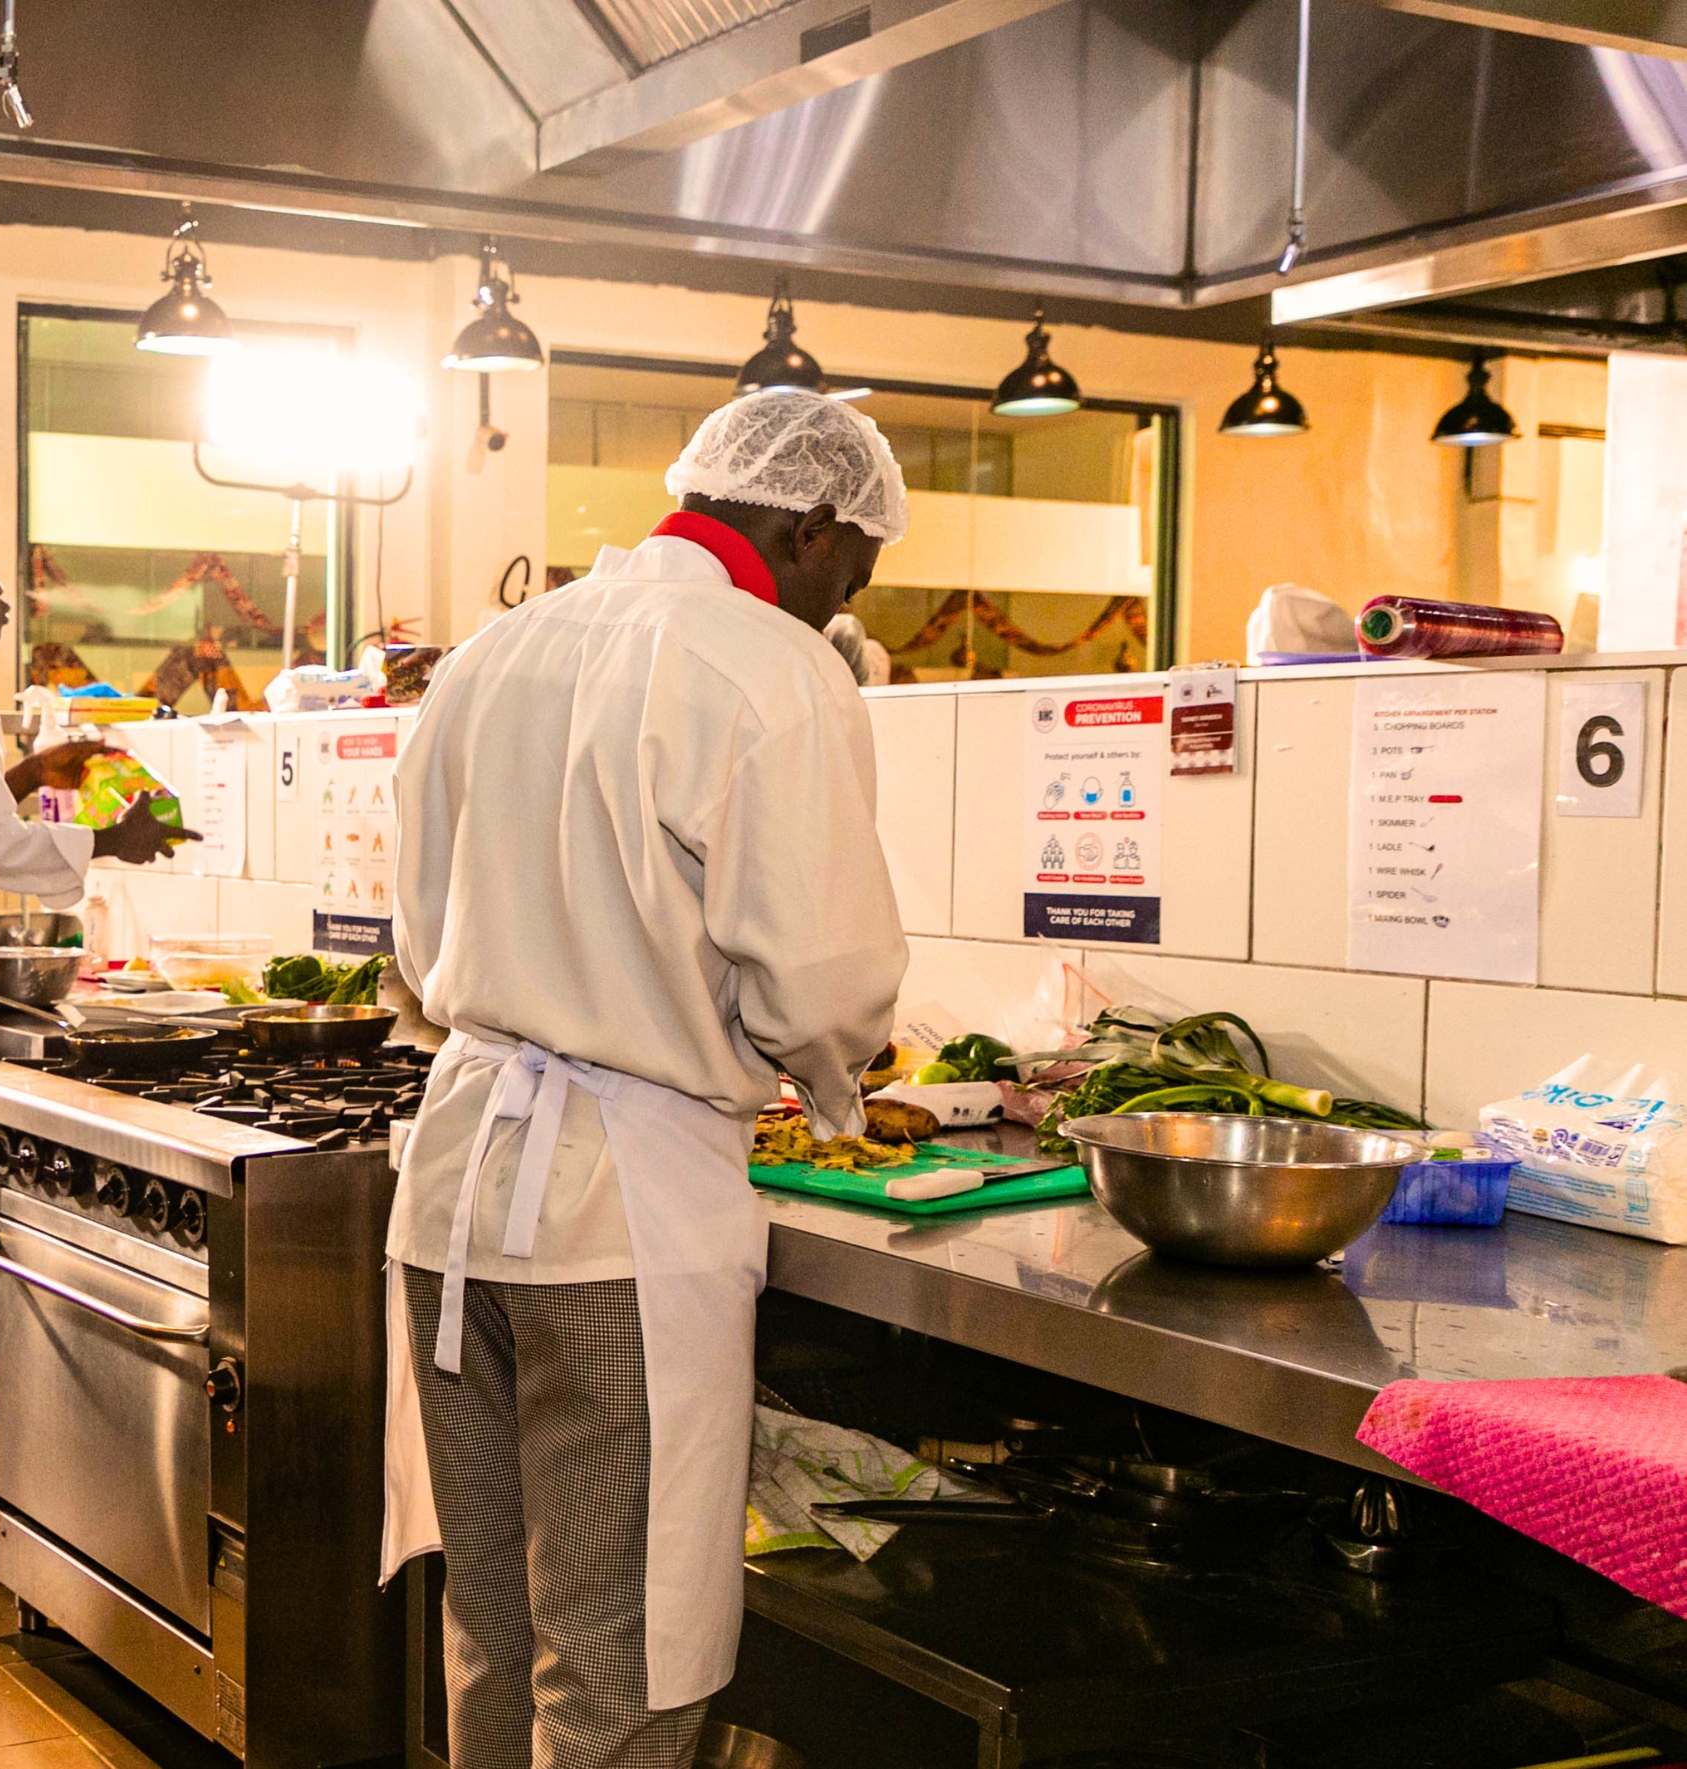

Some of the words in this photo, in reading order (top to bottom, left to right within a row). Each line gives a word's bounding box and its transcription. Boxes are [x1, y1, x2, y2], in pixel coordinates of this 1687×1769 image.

[1075, 701, 1134, 713] CORONAVIRUS
[1075, 710, 1142, 725] PREVENTION
[1404, 709, 1452, 717] ARRANGEMENT
[1454, 708, 1467, 716] PER
[1384, 722, 1427, 731] CHOPPING
[1429, 721, 1465, 730] BOARDS
[1381, 746, 1403, 755] POTS
[1576, 715, 1624, 787] 6
[1044, 753, 1069, 761] Protect
[1071, 751, 1098, 761] yourself
[1107, 751, 1129, 760] others
[281, 751, 294, 787] 5
[1380, 771, 1397, 779] PAN
[1403, 795, 1424, 803] TRAY
[1378, 819, 1415, 827] SKIMMER
[1377, 842, 1403, 851] LADLE
[1376, 867, 1397, 875] WIRE
[1400, 867, 1426, 876] WHISK
[1376, 890, 1406, 899] SPIDER
[1046, 907, 1071, 916] THANK
[1073, 908, 1089, 916] YOU
[1090, 908, 1106, 917] FOR
[1107, 909, 1136, 919] TAKING
[1050, 916, 1070, 924] CARE
[1071, 916, 1082, 925] OF
[1083, 917, 1104, 926] EACH
[1105, 918, 1131, 927] OTHER
[1374, 915, 1403, 924] MIXING
[1404, 916, 1428, 925] BOWL
[919, 1022, 944, 1042] FOOD
